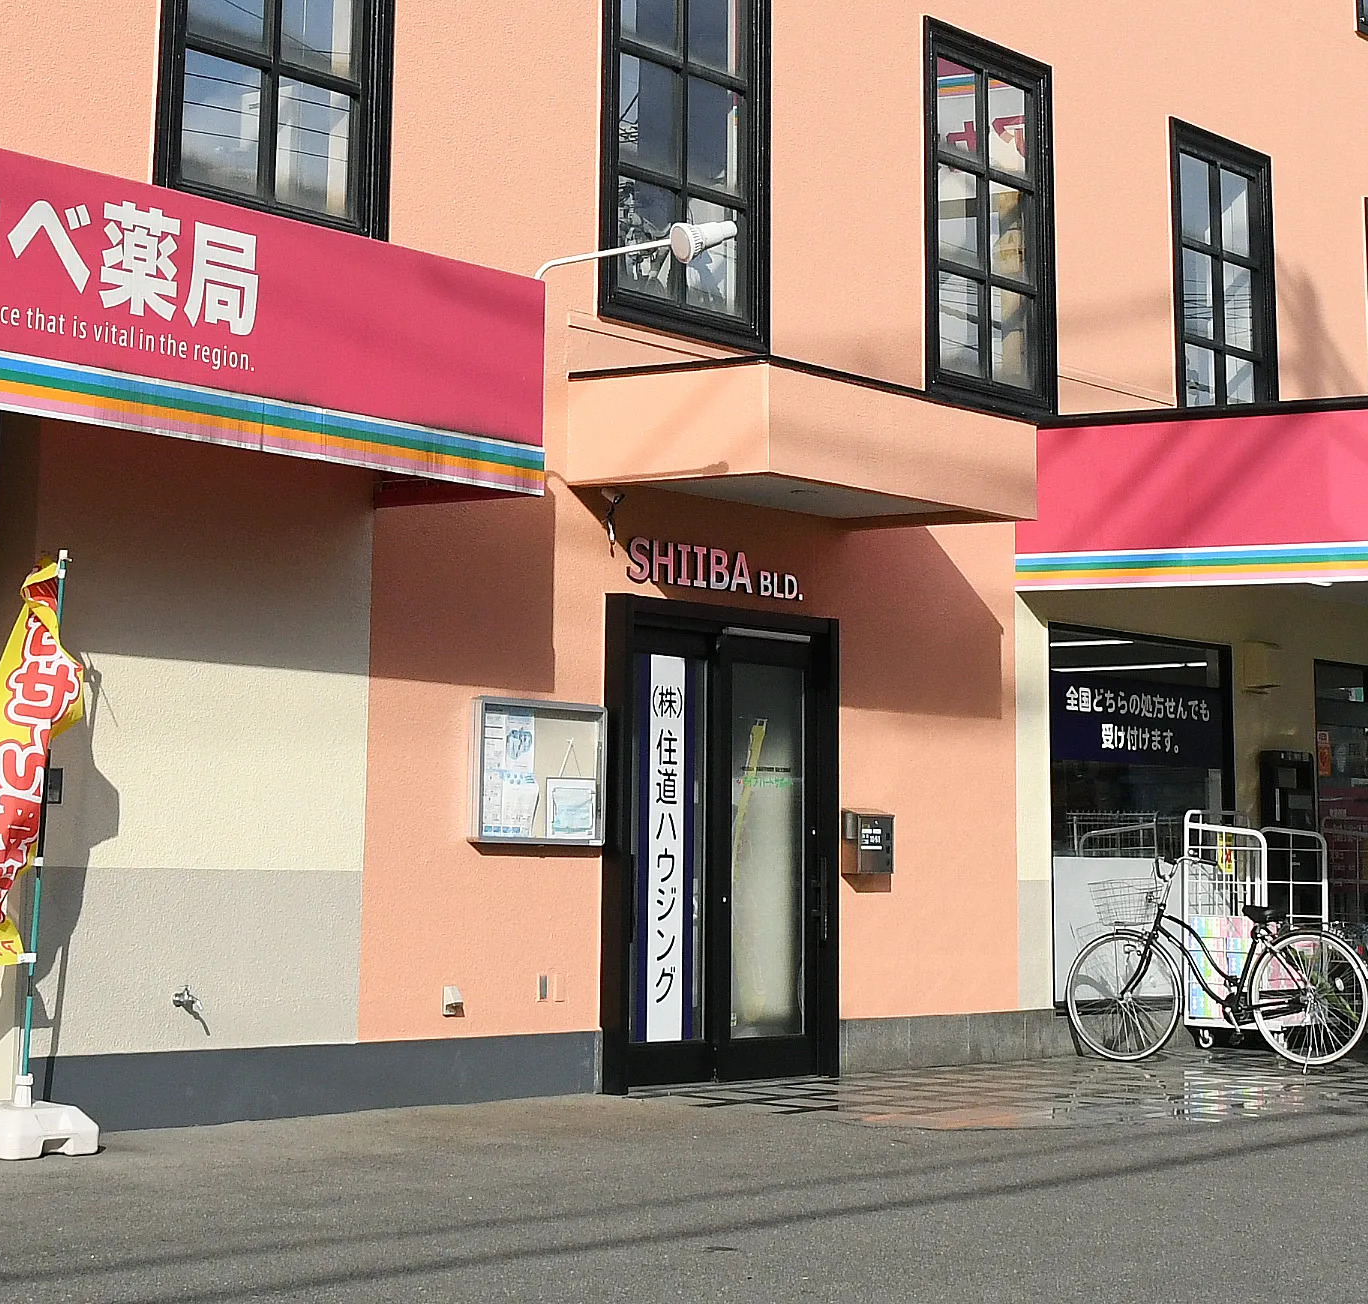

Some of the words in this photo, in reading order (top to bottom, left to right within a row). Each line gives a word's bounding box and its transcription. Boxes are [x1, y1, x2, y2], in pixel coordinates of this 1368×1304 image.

[25, 306, 66, 335] that
[72, 314, 88, 340] is
[92, 319, 135, 348] vital
[137, 326, 157, 352] in
[158, 328, 188, 360] the
[193, 341, 256, 372] region.
[628, 536, 752, 594] SHIIBA
[759, 571, 804, 601] BLD.
[1065, 685, 1210, 722] 全国どちらの処方せんでも
[1101, 723, 1179, 754] 受け付けます。
